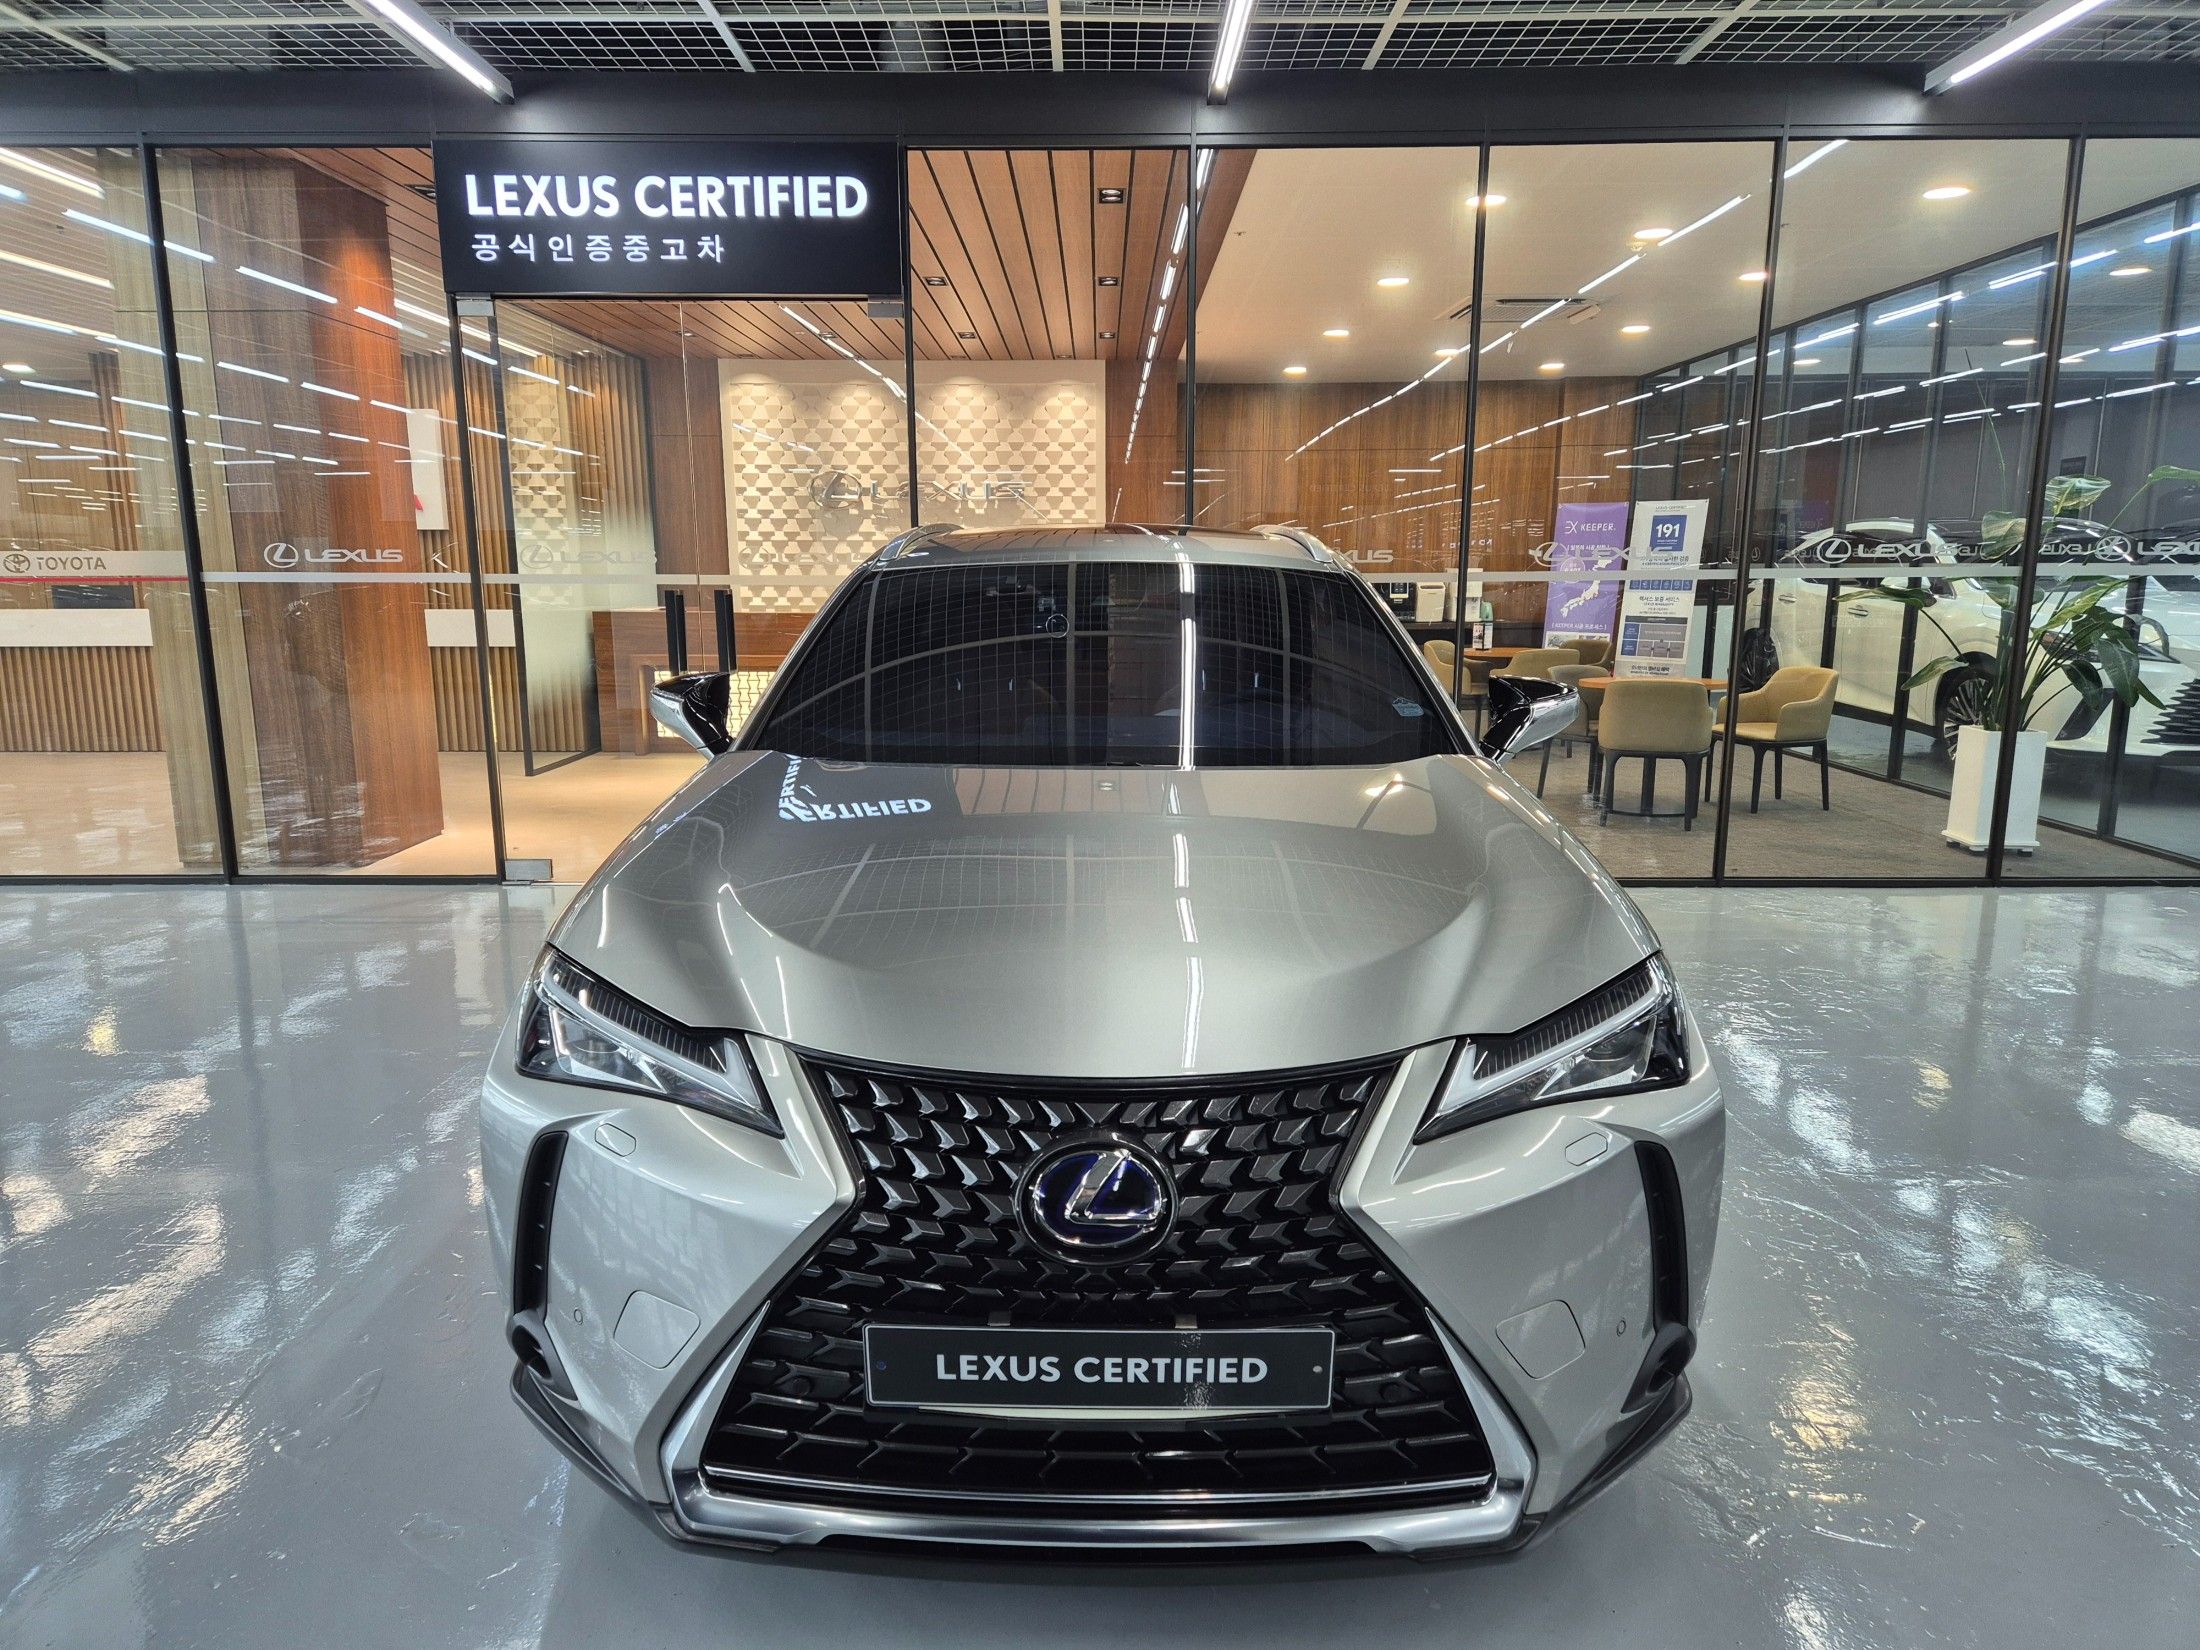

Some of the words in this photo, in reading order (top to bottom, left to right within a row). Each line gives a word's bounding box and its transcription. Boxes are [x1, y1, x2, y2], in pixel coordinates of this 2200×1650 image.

[465, 174, 620, 217] LEXUS
[634, 175, 868, 217] CERTIFIED
[1580, 522, 1614, 532] KEEPER
[1655, 523, 1680, 538] 191
[304, 549, 404, 563] LEXUS
[1336, 549, 1394, 563] XUS
[1858, 543, 1958, 557] LEXUS
[36, 556, 107, 571] TOYOTA
[936, 1353, 1062, 1383] LEXUS
[1074, 1356, 1269, 1384] CERTIFIED
